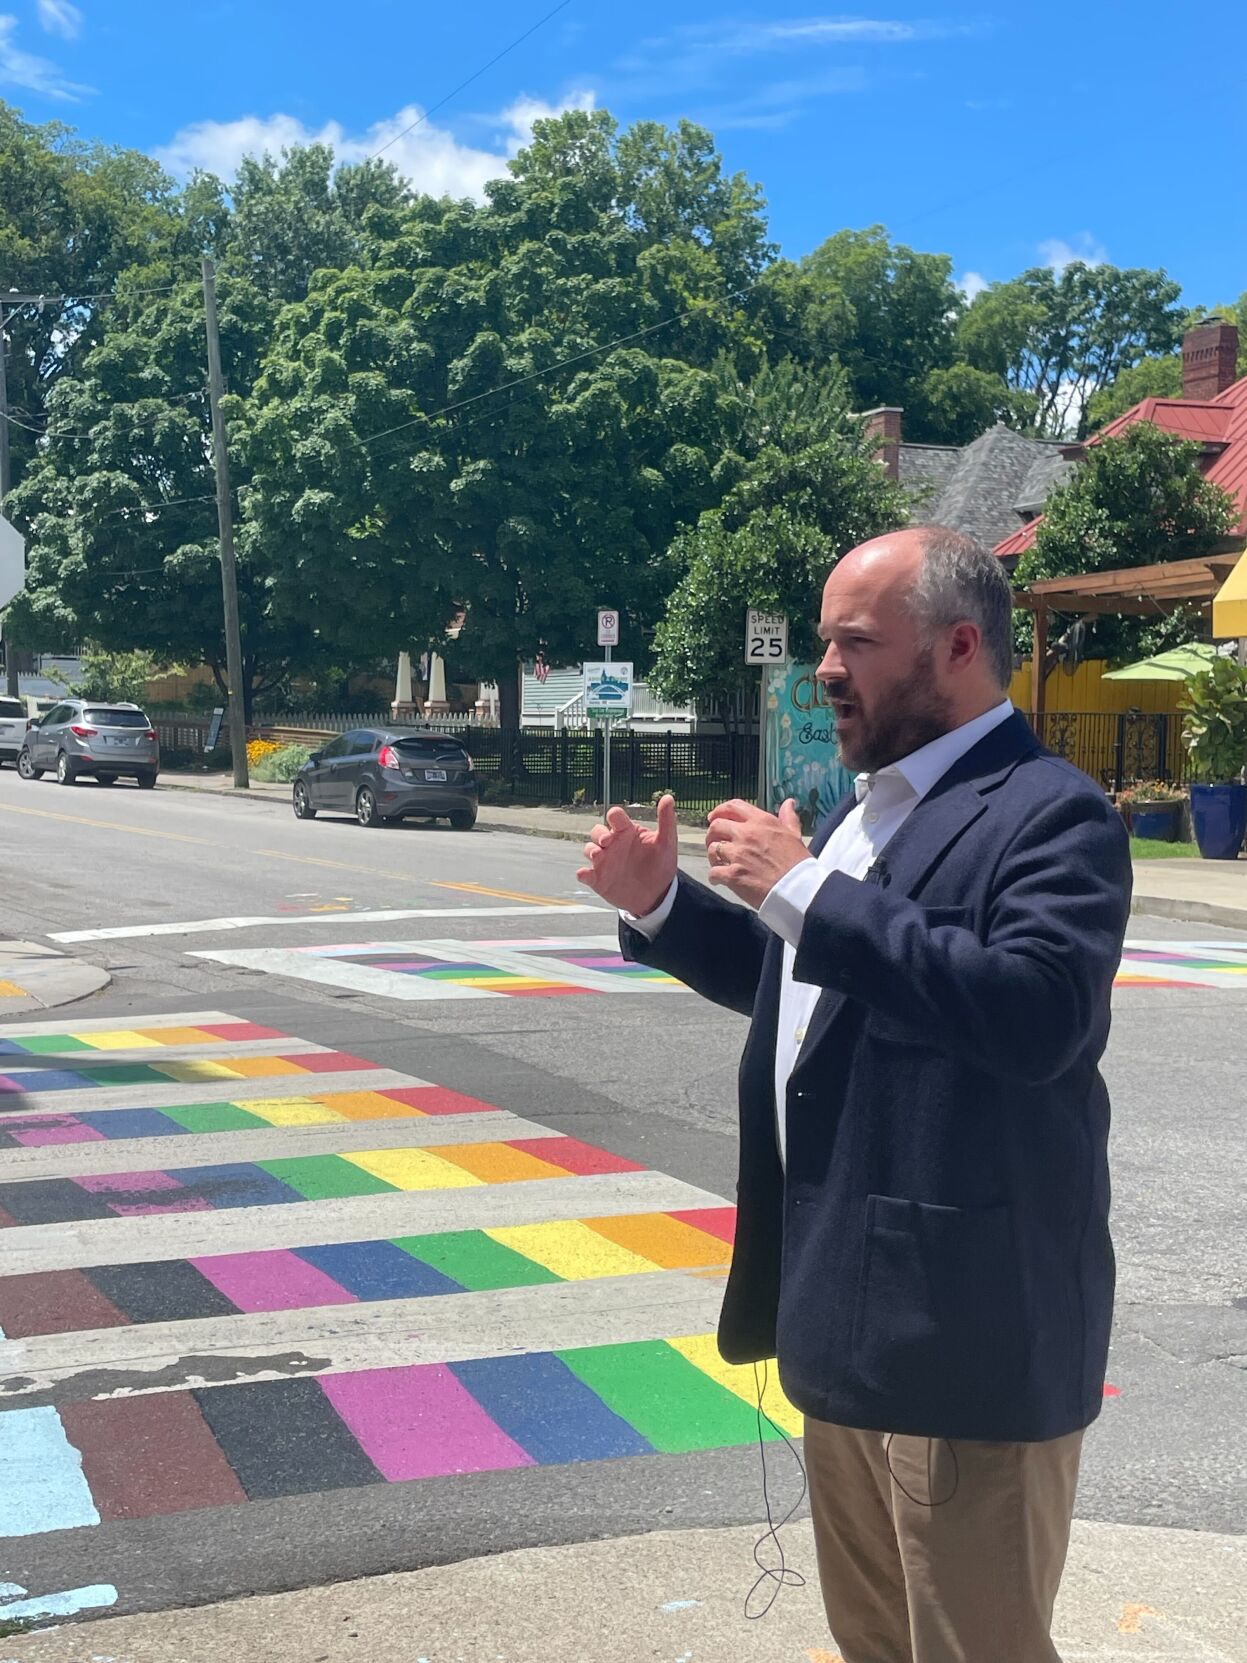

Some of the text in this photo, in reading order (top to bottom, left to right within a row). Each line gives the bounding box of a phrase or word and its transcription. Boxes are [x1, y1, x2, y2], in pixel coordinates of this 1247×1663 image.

[750, 614, 785, 625] SPEED
[753, 626, 781, 636] LIMIT
[750, 637, 783, 657] 25
